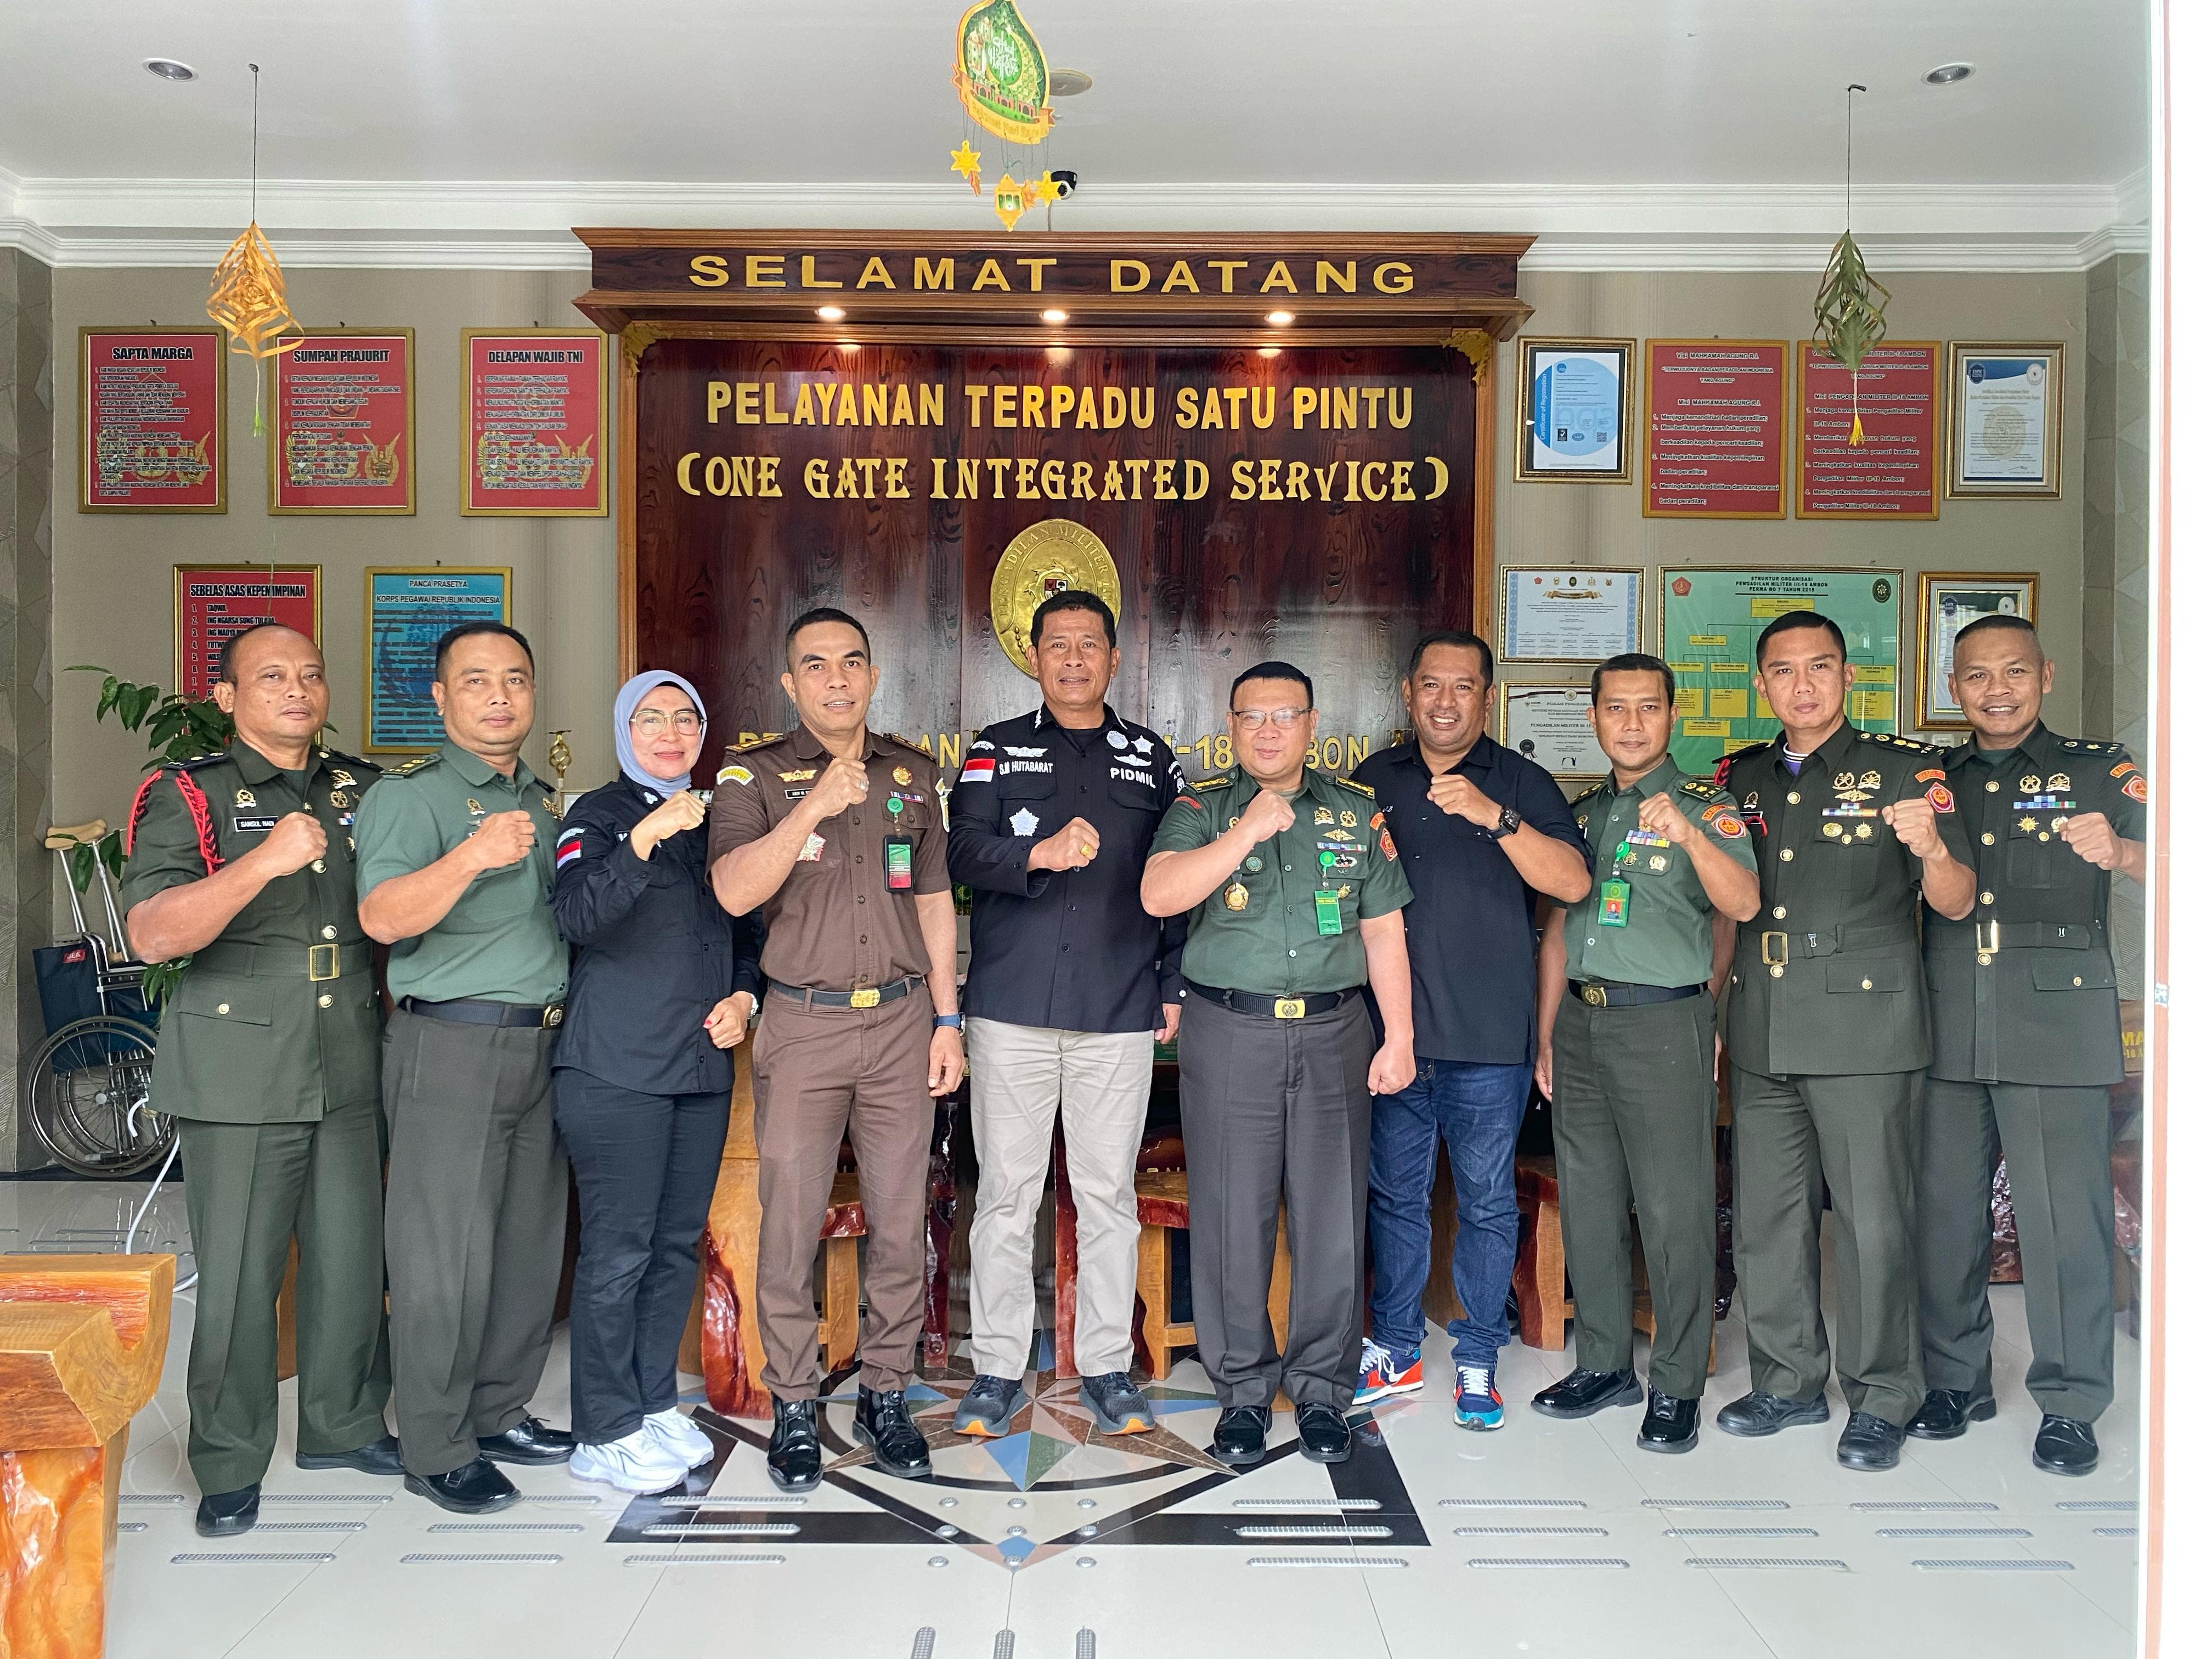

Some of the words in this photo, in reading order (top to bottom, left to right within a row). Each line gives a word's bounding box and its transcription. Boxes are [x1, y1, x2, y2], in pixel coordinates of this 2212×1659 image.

[689, 256, 1059, 292] SELAMAT
[1110, 259, 1415, 294] DATANG
[112, 347, 149, 359] SAPTA
[151, 347, 193, 360] MARGA
[294, 350, 338, 363] SUMPAH
[340, 349, 390, 363] PRAJURIT
[488, 351, 532, 363] DELAPAN
[533, 351, 565, 363] WAJIB
[567, 351, 583, 363] TNI
[707, 381, 945, 427] PELAYANAN
[965, 385, 1156, 430] TERPADU
[1176, 387, 1277, 430] SATU
[1294, 388, 1414, 430] PINTU
[805, 456, 910, 499] GATE
[930, 458, 1210, 501] INTEGRATED
[1056, 524, 1109, 574] MILITER
[190, 584, 223, 597] SEBELAS
[224, 584, 246, 597] ASAS
[409, 579, 432, 588] PANCA
[207, 616, 217, 624] ING
[207, 629, 217, 637] ING
[1011, 760, 1053, 774] HUTABARAT
[1110, 768, 1156, 789] PIDMIL
